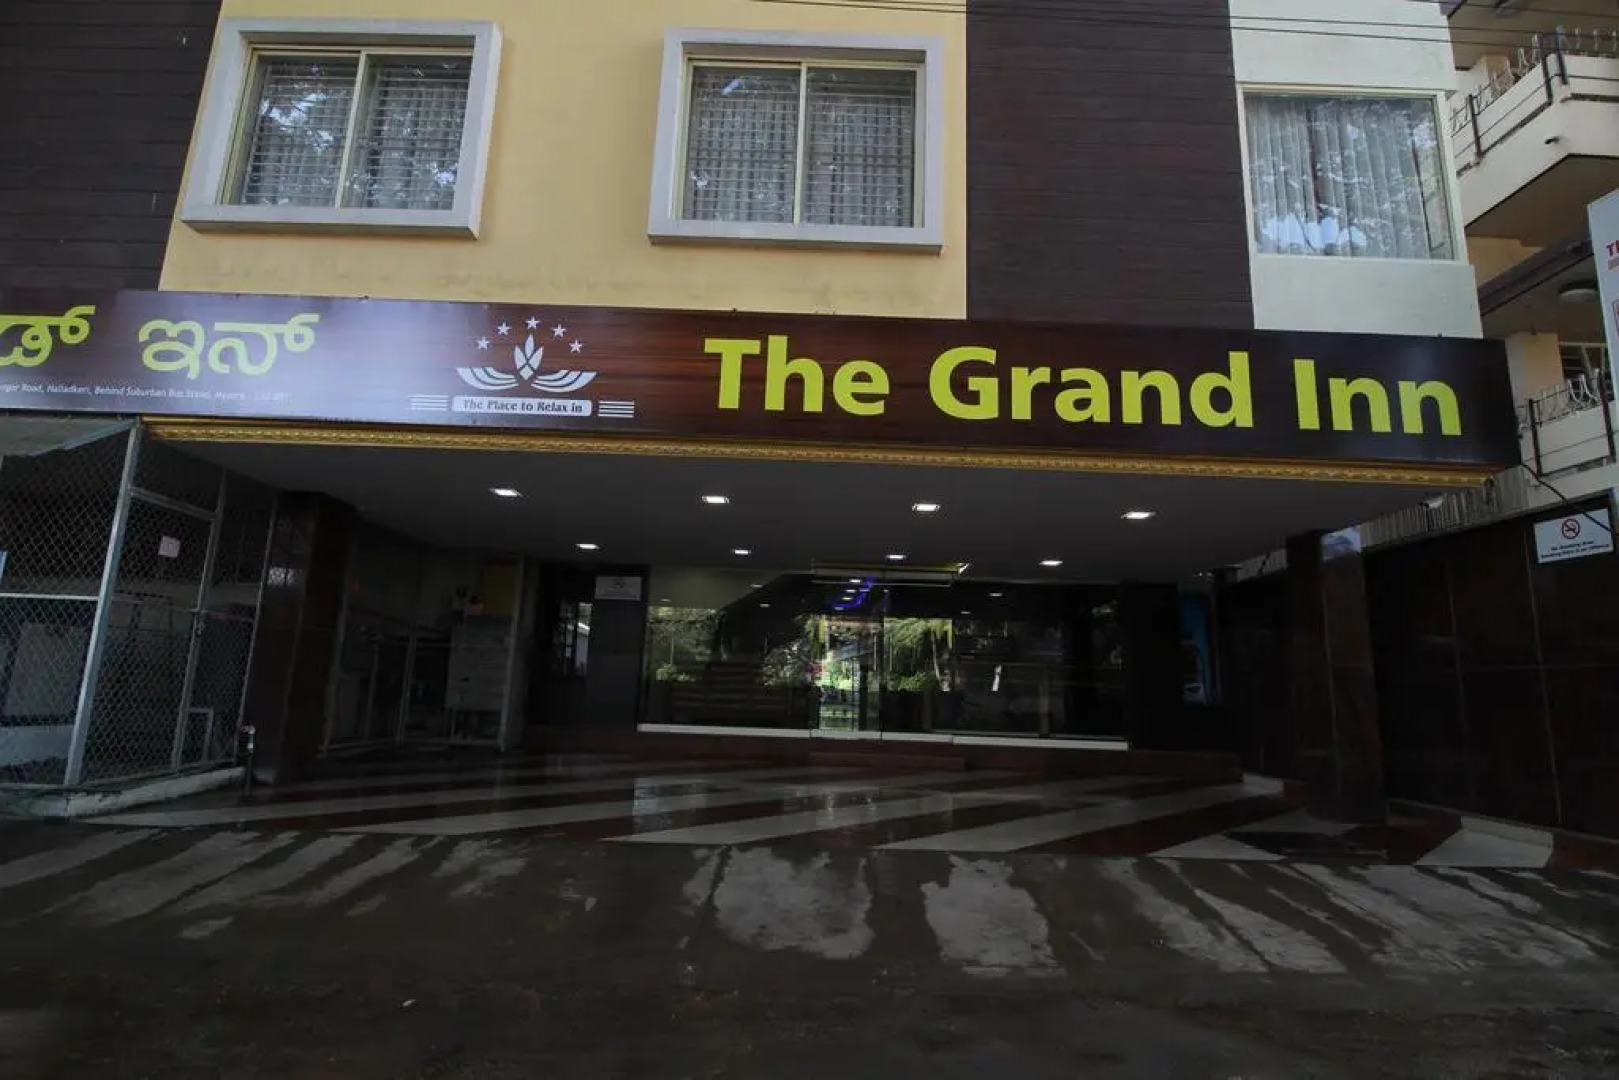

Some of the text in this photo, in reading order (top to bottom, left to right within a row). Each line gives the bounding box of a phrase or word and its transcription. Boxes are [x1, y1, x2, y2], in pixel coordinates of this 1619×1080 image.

[139, 313, 319, 379] ಇನ್
[463, 399, 583, 413] The Place to Relax in
[704, 335, 1462, 435] The Grand Inn
